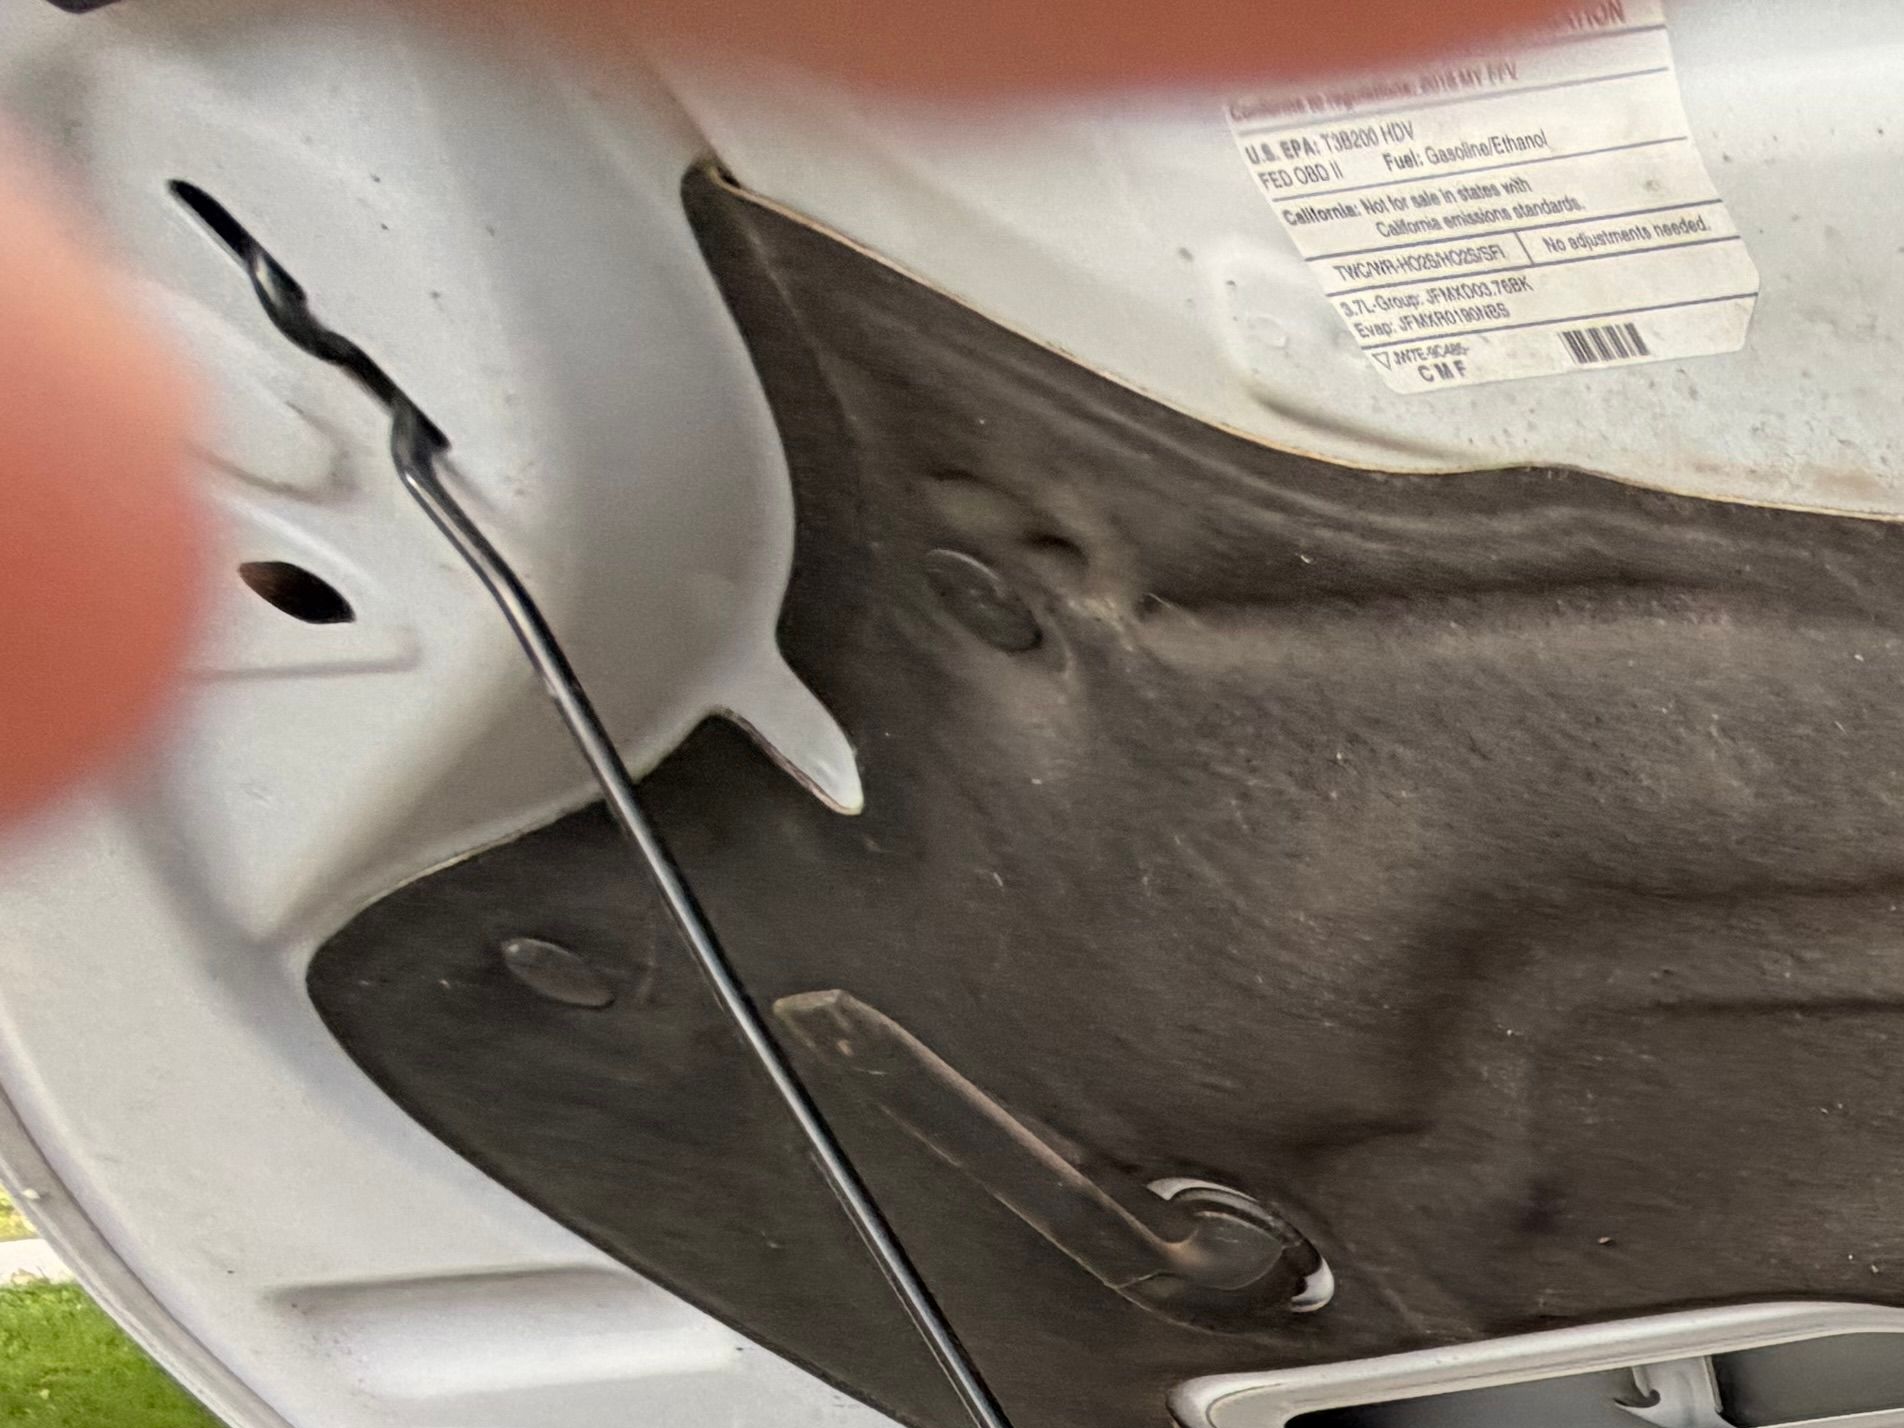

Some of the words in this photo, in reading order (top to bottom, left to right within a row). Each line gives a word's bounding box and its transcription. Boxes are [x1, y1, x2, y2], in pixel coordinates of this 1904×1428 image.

[1245, 143, 1280, 165] U.S.
[1281, 136, 1320, 159] EPA:
[1322, 127, 1379, 153] T3B200
[1382, 120, 1415, 142] HDV
[1382, 150, 1423, 172] Fuel:
[1426, 129, 1549, 165] Gasoline/Ethanol
[1258, 168, 1293, 191] FED
[1295, 163, 1328, 185] OBD
[1330, 162, 1344, 180] II
[1283, 204, 1360, 226] California:
[1363, 196, 1387, 216] Not
[1391, 193, 1408, 211] for
[1412, 191, 1439, 208] sale
[1443, 188, 1455, 204] in
[1457, 182, 1499, 201] states
[1502, 176, 1532, 195] with
[1376, 216, 1442, 238] California
[1443, 207, 1511, 231] emissions
[1512, 196, 1586, 219] standards.
[1543, 235, 1566, 253] No
[1570, 226, 1652, 251] adjustments
[1653, 214, 1711, 238] needed.
[1354, 321, 1396, 340] Evap:
